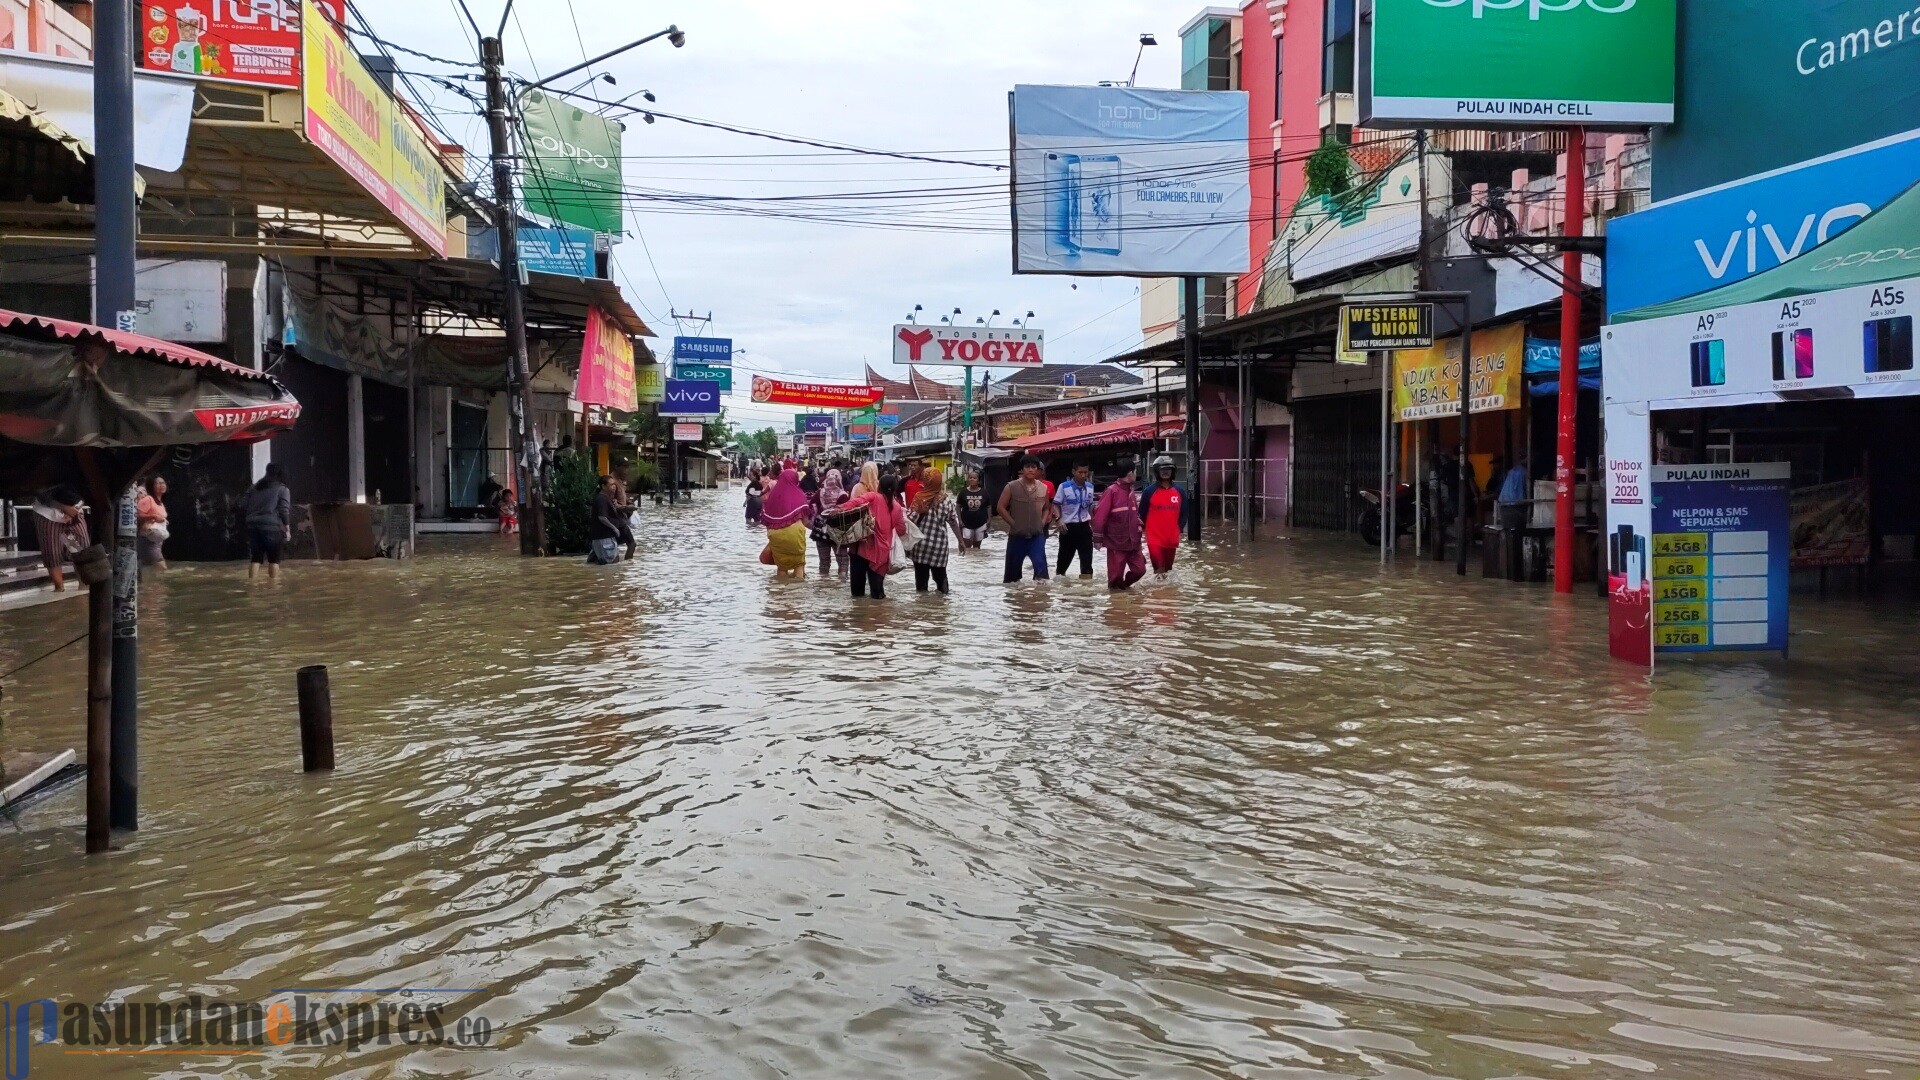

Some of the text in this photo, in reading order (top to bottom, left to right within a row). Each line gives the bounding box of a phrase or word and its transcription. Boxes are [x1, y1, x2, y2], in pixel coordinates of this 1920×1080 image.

[324, 33, 382, 148] Rinnai
[1098, 99, 1169, 121] honor
[1457, 101, 1593, 116] PULAU INDAH CELL
[1137, 191, 1224, 204] FOUR CAMERAS, FULL VIEW
[1870, 286, 1905, 308] A5s
[1351, 307, 1418, 322] WESTERN
[1780, 298, 1817, 320] A5 2020
[1372, 321, 1418, 336] UNION
[1697, 314, 1715, 331] A9
[681, 343, 729, 353] SAMSUNG
[1351, 340, 1369, 348] TEMPAT
[1403, 338, 1416, 346] UANG
[1417, 337, 1431, 346] TUNAI
[937, 339, 1043, 363] YOGYA
[1442, 353, 1505, 379] KOENG
[667, 389, 711, 401] vivo
[781, 382, 809, 391] TELUR
[823, 386, 846, 394] TOKO
[848, 388, 869, 396] KAMI
[215, 412, 246, 427] REAL
[249, 410, 269, 424] BIG
[1609, 459, 1642, 471] Unbox
[1615, 473, 1638, 484] Your
[1667, 469, 1750, 481] PULAU INDAH
[1614, 486, 1639, 497] 2020
[1672, 507, 1749, 518] NELPON & SMS
[1680, 516, 1741, 527] SEPUASNYA
[1661, 542, 1700, 553] 4.5GB
[1668, 564, 1694, 575] 8GB
[1663, 588, 1698, 599] 15GB
[1664, 610, 1699, 621] 25GB
[1665, 633, 1699, 644] 37GB
